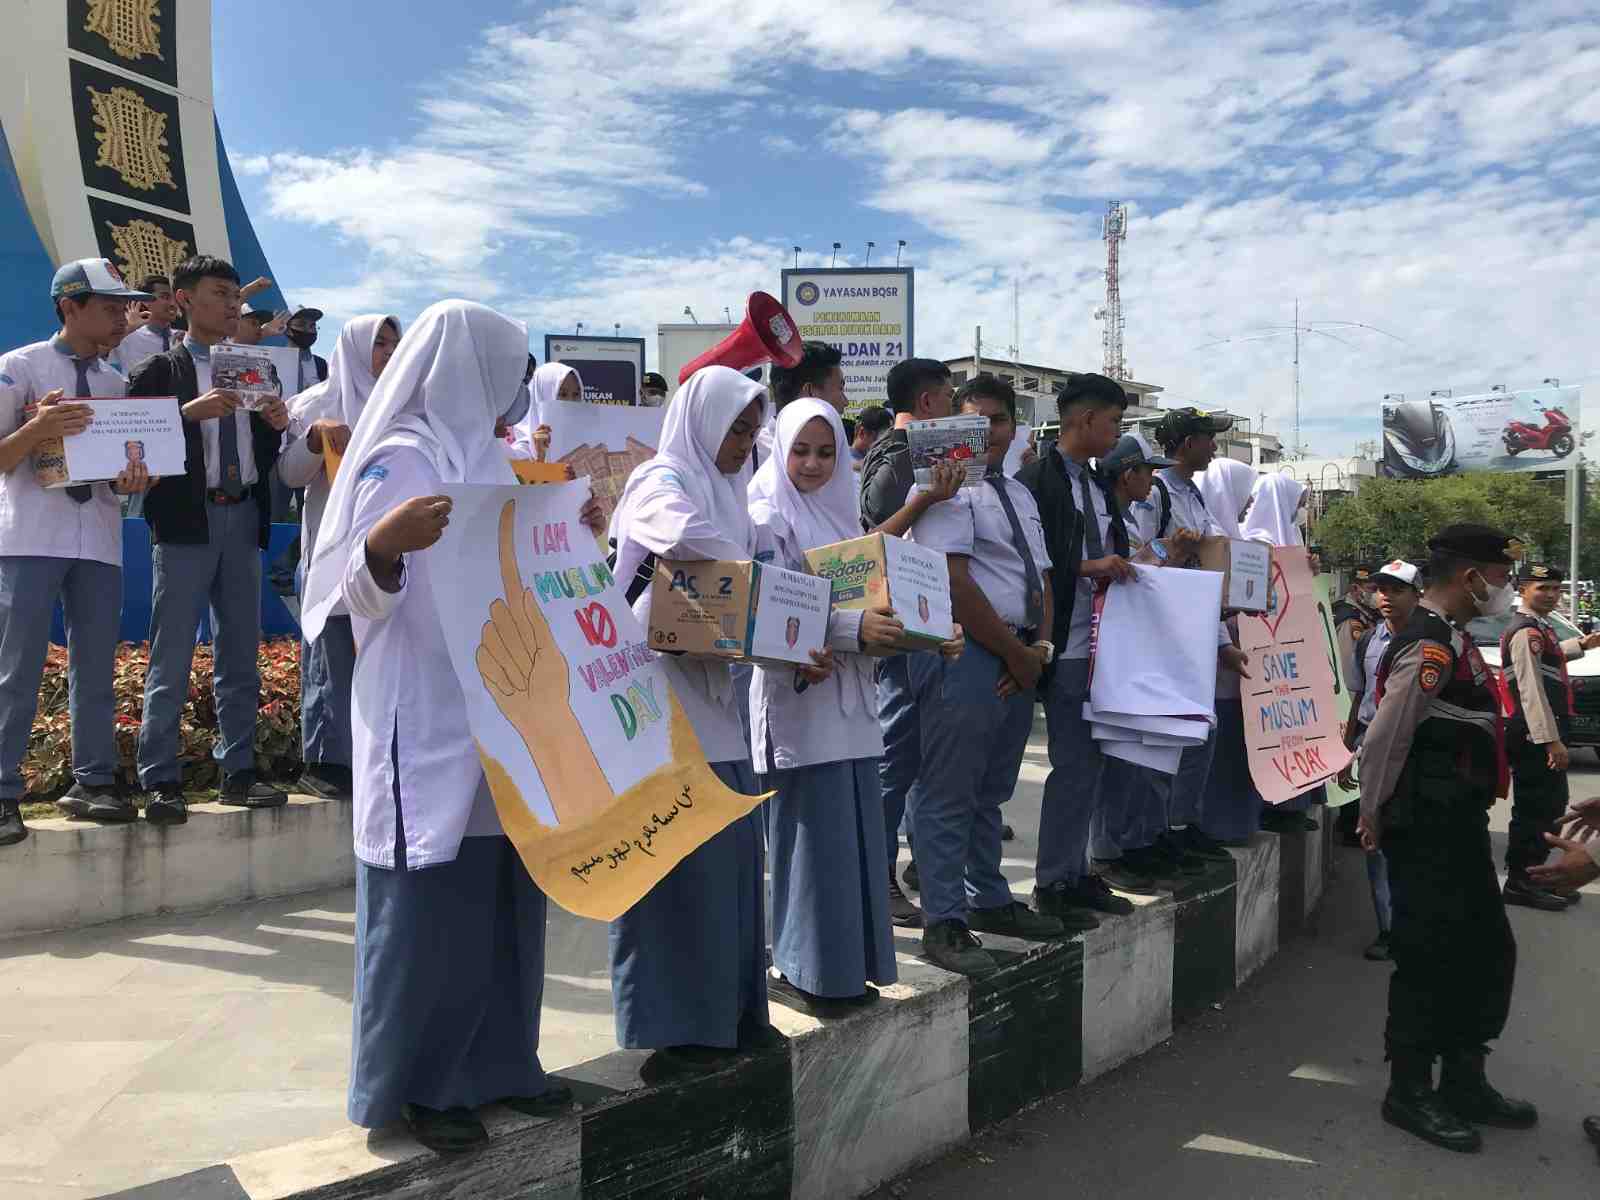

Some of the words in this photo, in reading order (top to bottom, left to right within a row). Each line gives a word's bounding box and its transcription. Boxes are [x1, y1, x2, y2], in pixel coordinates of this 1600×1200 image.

[823, 287, 871, 298] YAYASAN
[872, 287, 898, 298] BQSR
[886, 341, 903, 356] 21
[532, 525, 541, 556] I
[543, 521, 571, 555] AM
[574, 601, 618, 649] NO
[1262, 651, 1299, 683] SAVE
[609, 677, 663, 742] DAY
[1259, 696, 1319, 734] MUSLIM
[1272, 746, 1329, 785] V-DAY
